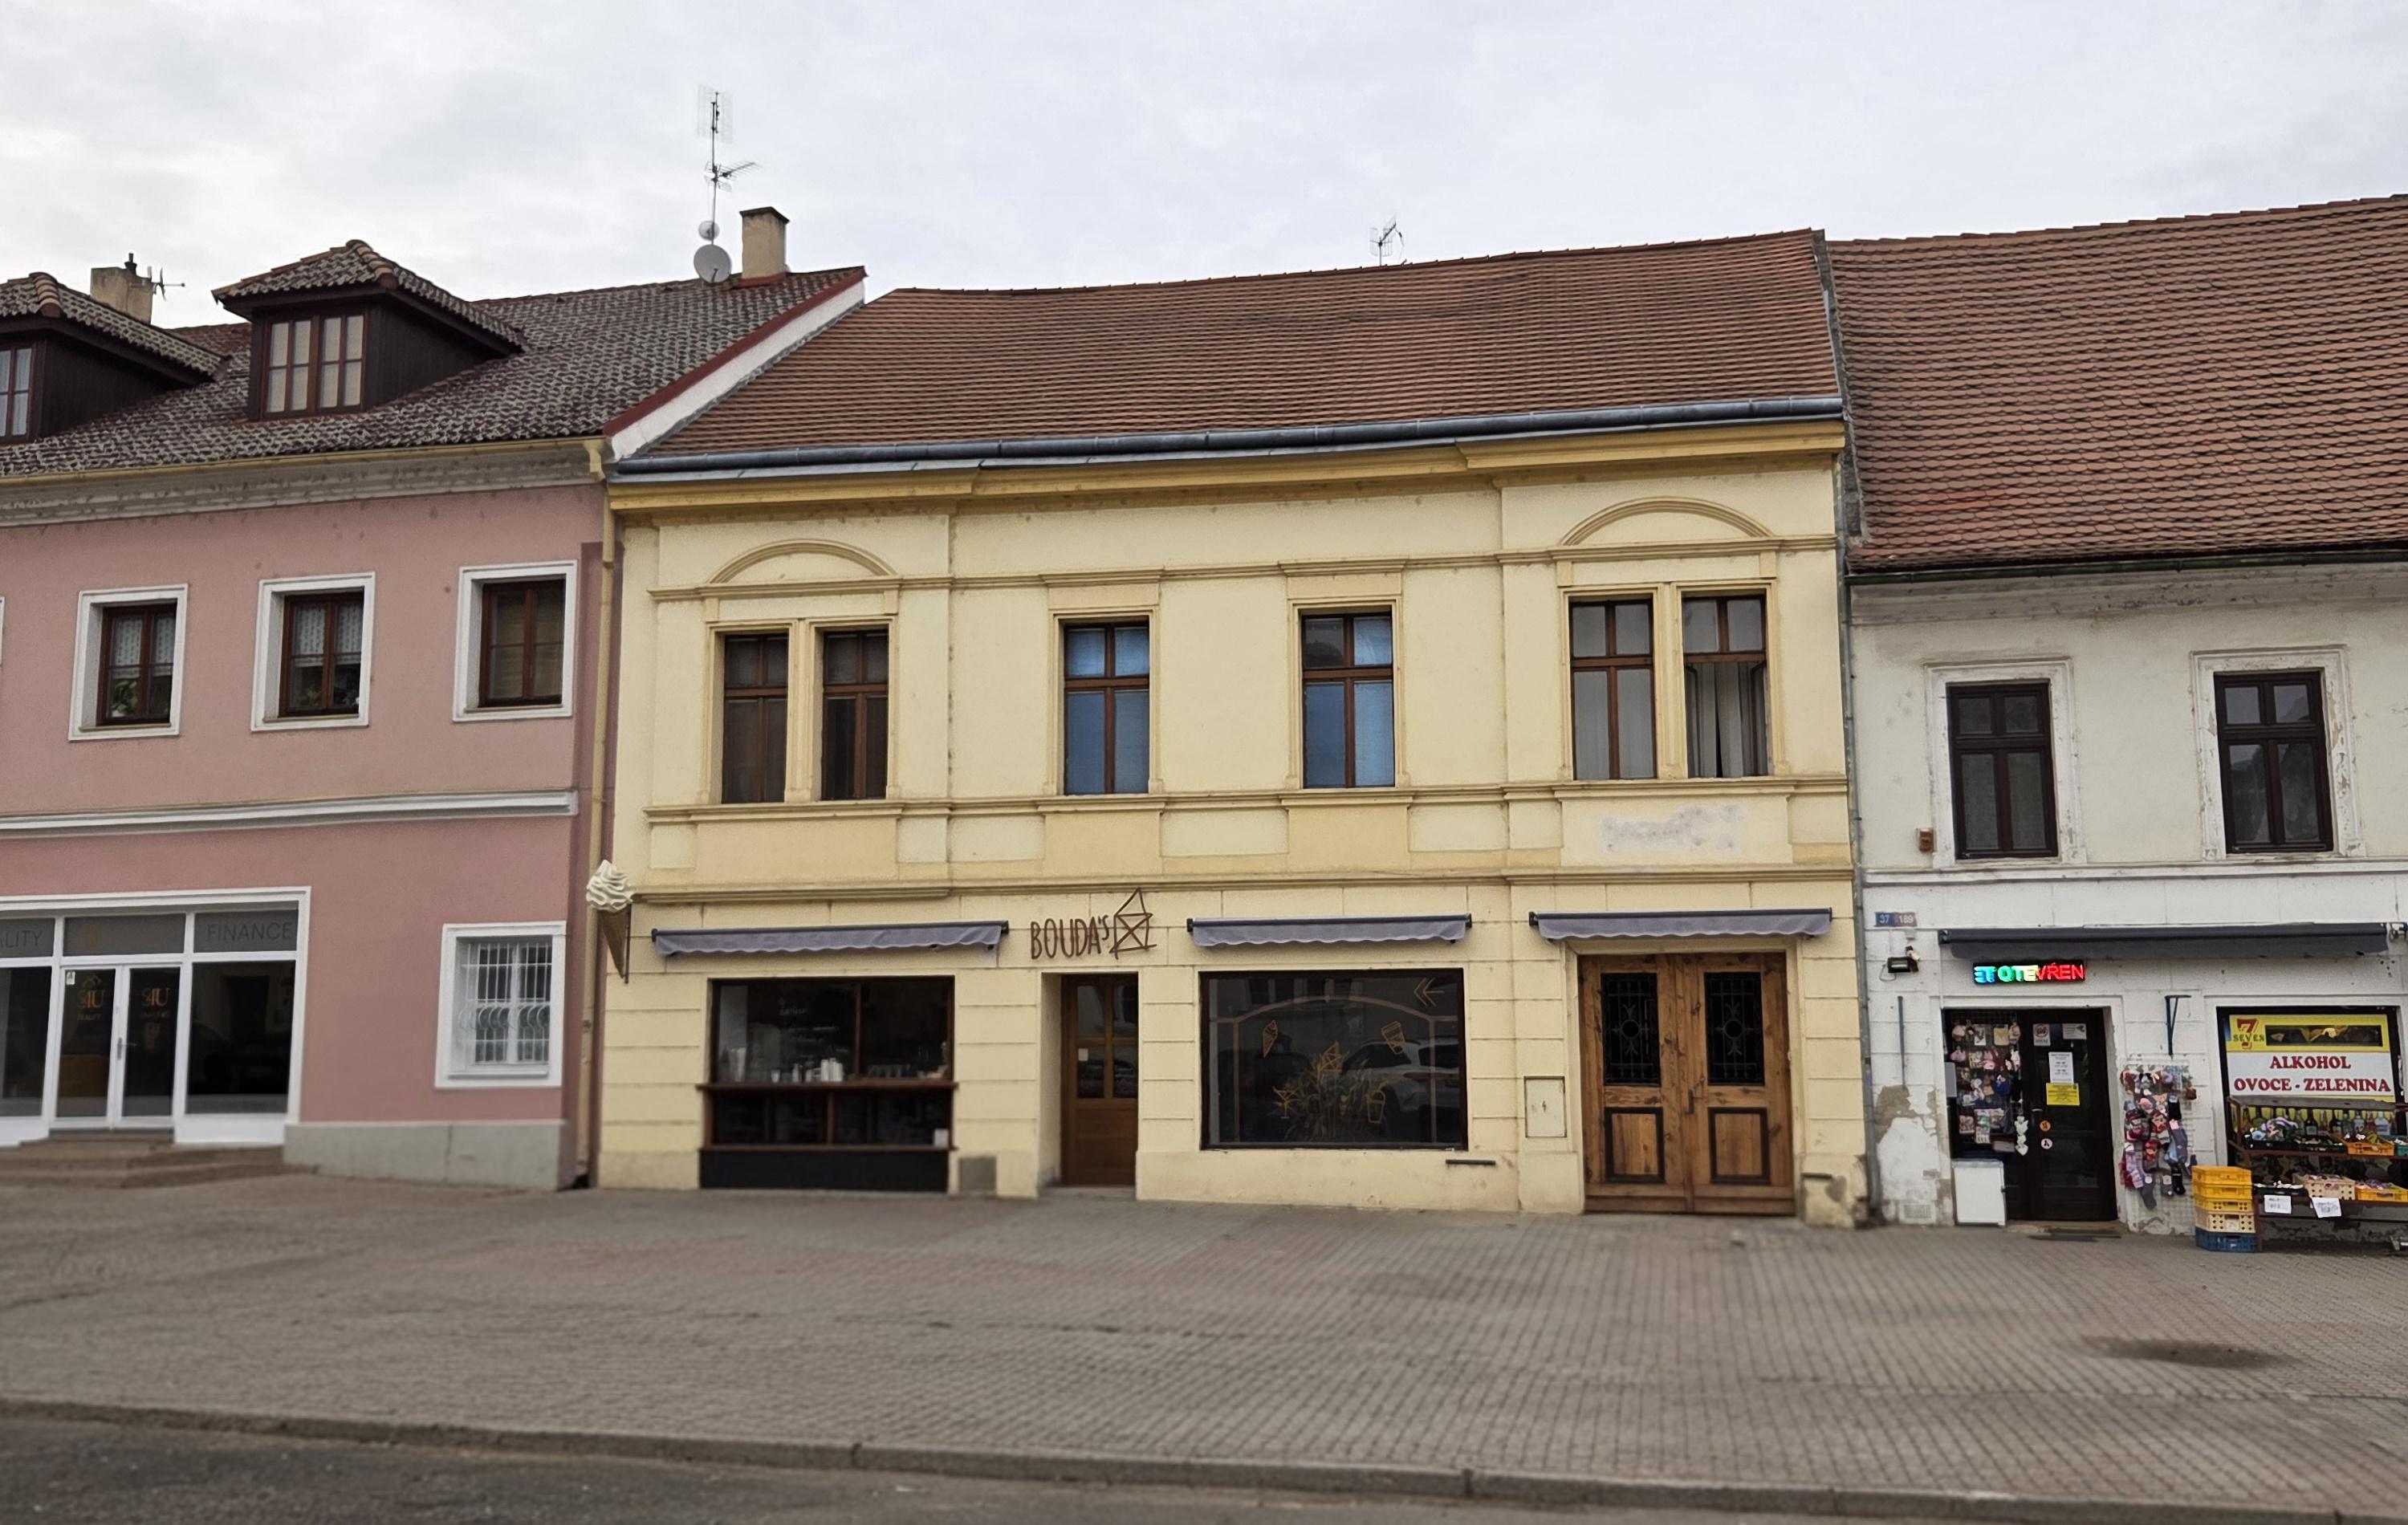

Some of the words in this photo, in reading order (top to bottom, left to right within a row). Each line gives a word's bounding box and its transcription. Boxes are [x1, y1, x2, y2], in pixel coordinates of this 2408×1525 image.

[1879, 914, 1890, 924] 37
[0, 930, 43, 948] LITY
[207, 921, 293, 941] FINANCE
[1031, 915, 1110, 959] BOUDA'S
[1997, 962, 2084, 982] OTEVŘEN
[2232, 1034, 2264, 1042] SEVEN
[2270, 1055, 2352, 1069] ALKOHOL
[2234, 1078, 2292, 1092] OVOCE
[2303, 1078, 2391, 1092] ZELENINA
